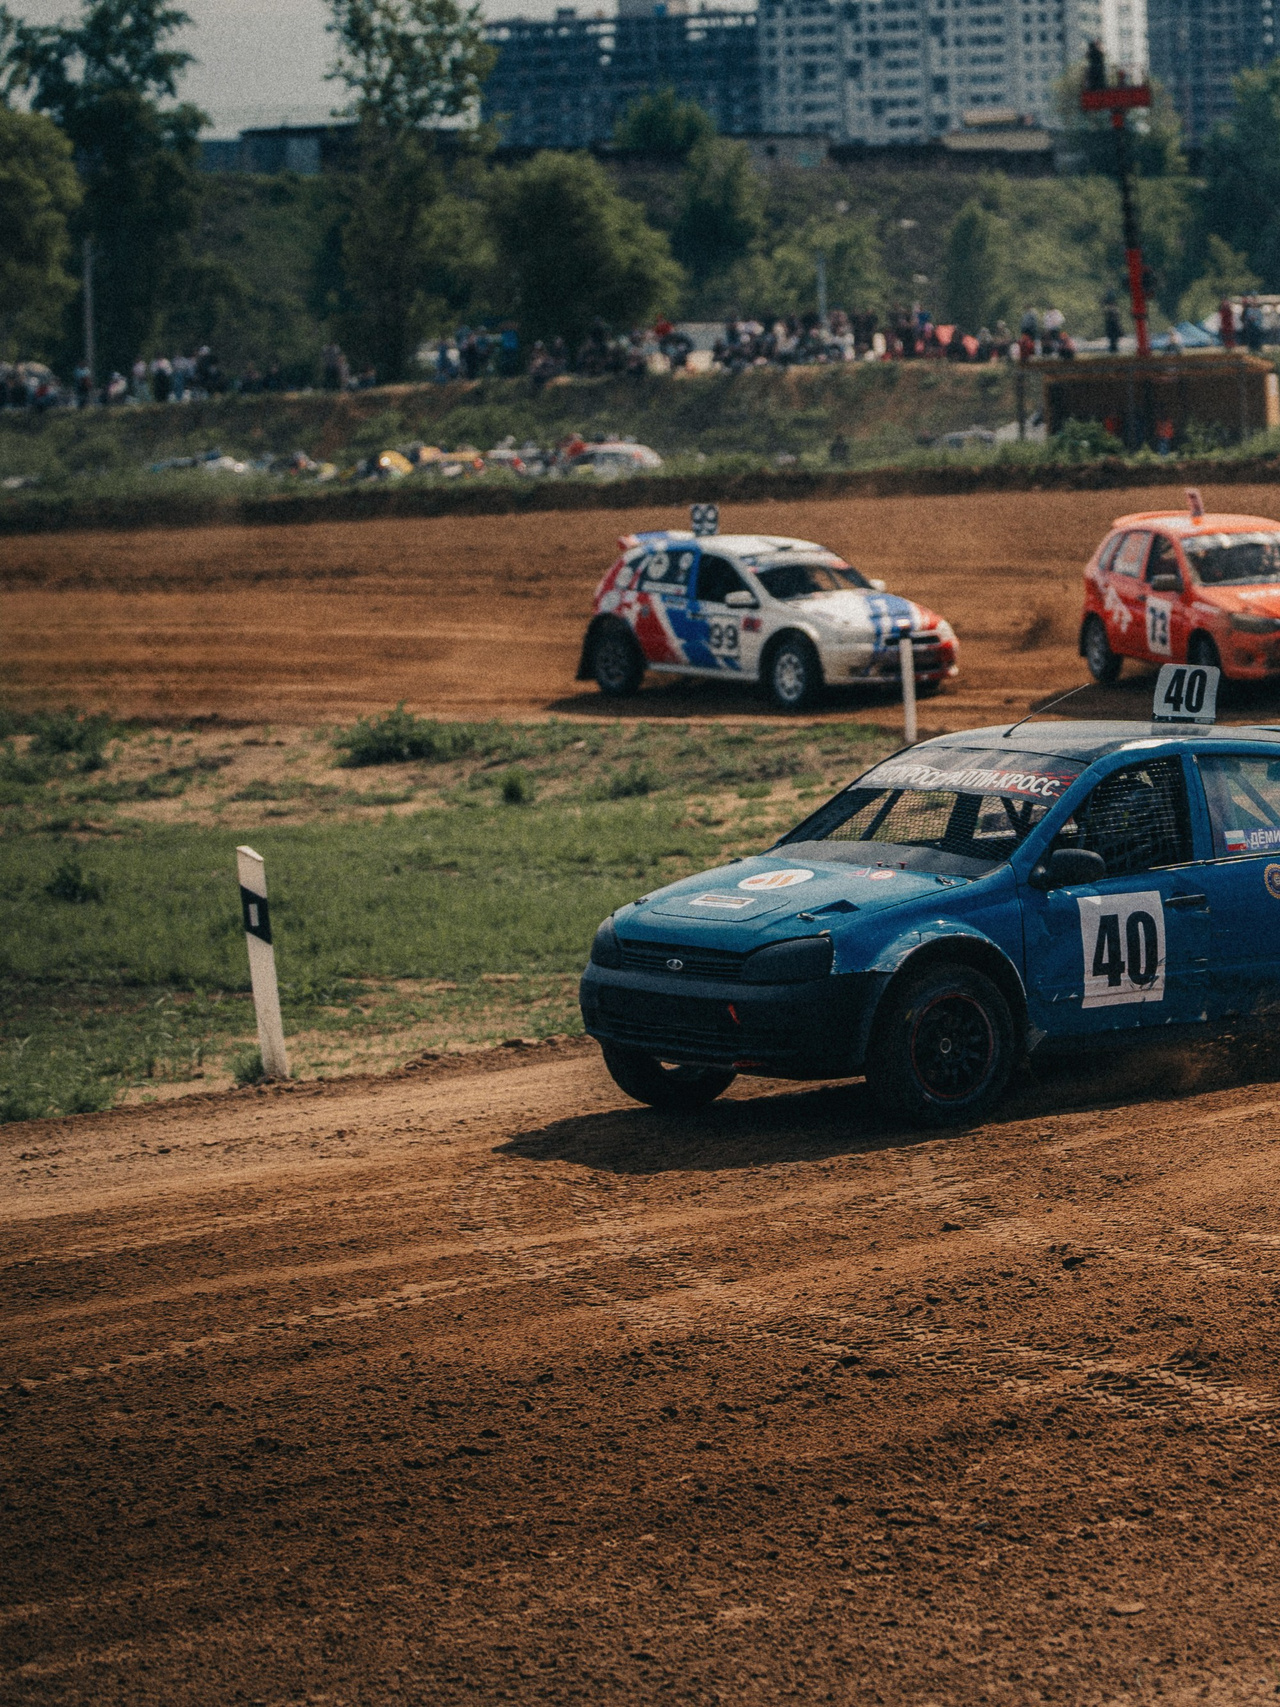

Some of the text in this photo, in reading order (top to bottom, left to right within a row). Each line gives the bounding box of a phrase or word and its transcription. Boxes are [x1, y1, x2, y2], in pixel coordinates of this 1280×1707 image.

[710, 623, 739, 650] 99
[1164, 668, 1208, 713] 40
[1092, 910, 1159, 988] 40
